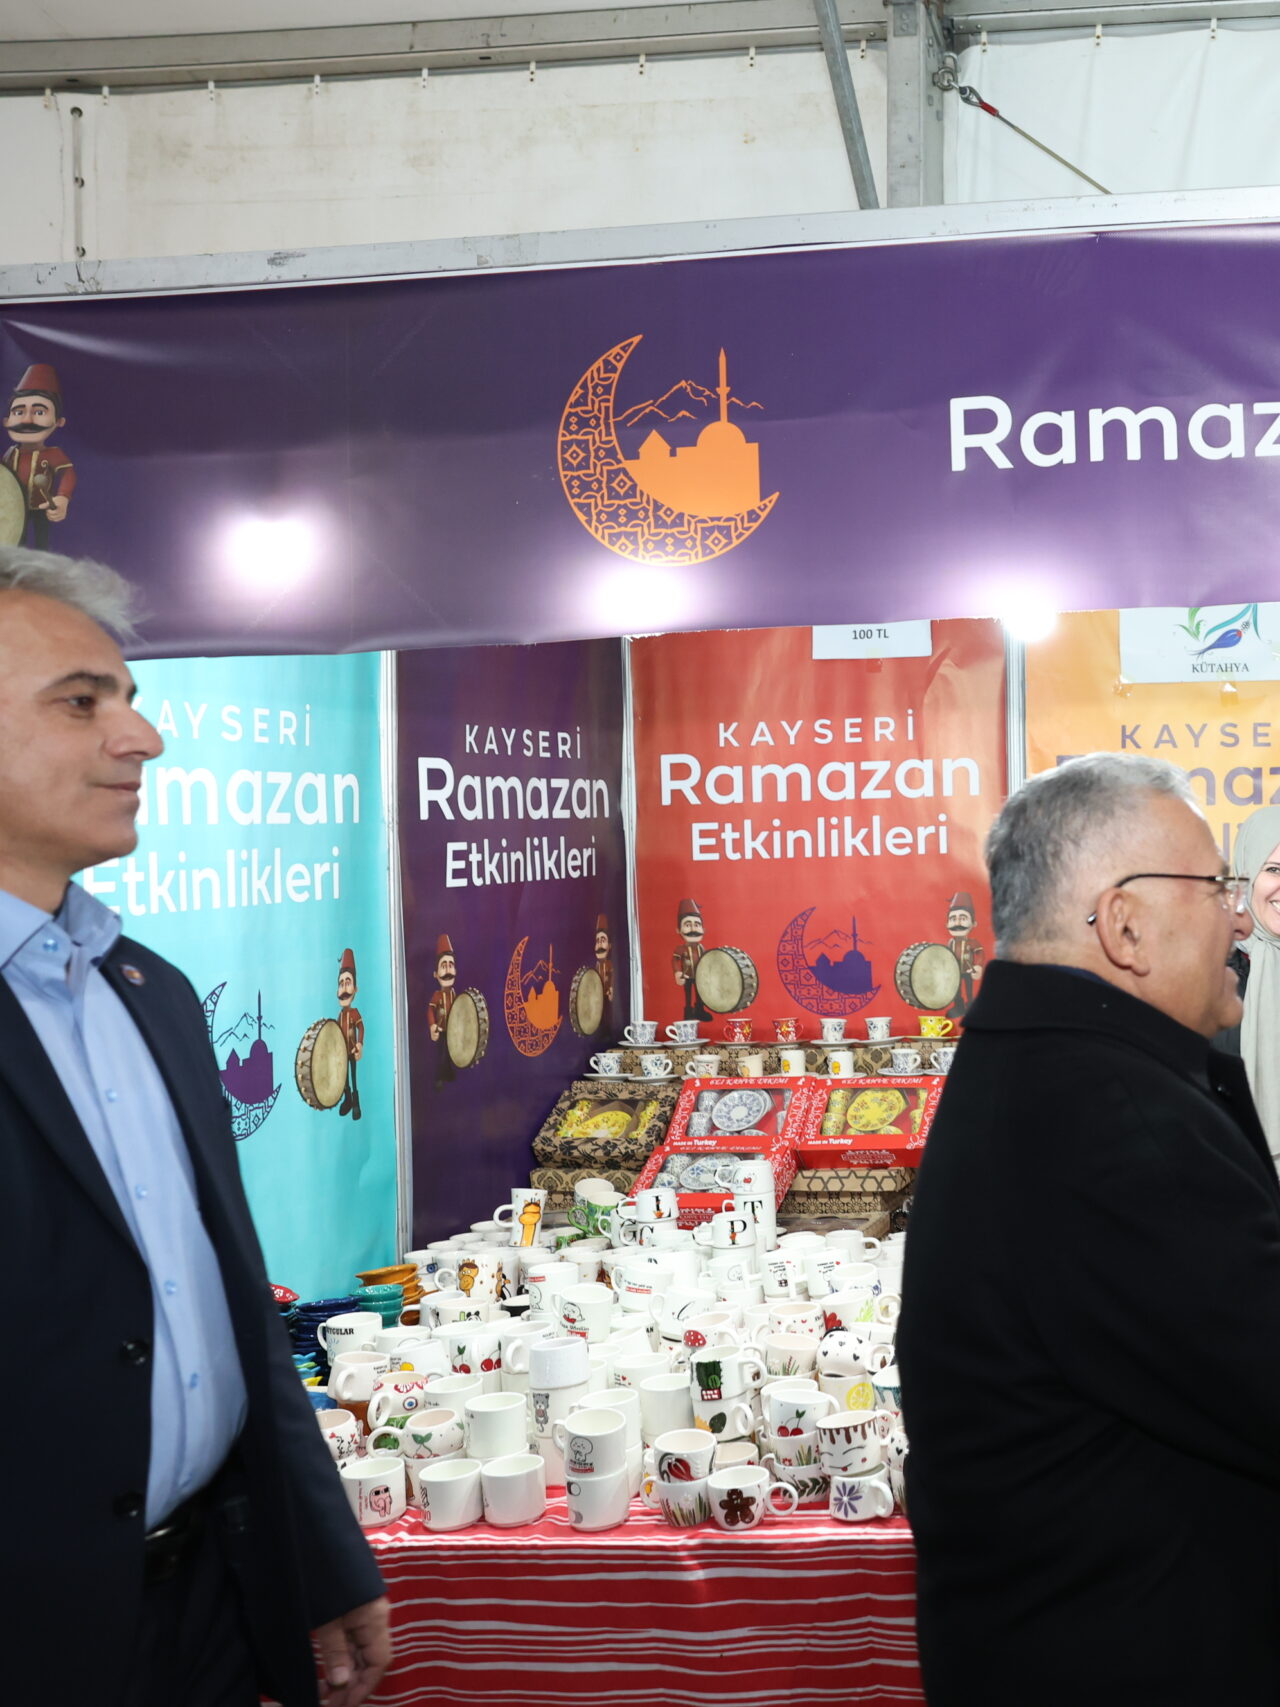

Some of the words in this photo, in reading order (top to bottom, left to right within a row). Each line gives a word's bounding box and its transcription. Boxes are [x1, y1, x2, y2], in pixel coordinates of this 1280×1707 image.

[852, 629, 873, 640] 100
[876, 628, 889, 639] TL
[1191, 662, 1250, 673] KÜTAHYA
[131, 696, 311, 747] AYSERİ
[465, 724, 581, 759] KAYSERİ
[718, 708, 914, 748] KAYSERİ
[135, 766, 360, 826] mazan
[417, 756, 610, 821] Ramazan
[659, 753, 980, 806] Ramazan
[691, 813, 948, 861] Etkinlikleri
[83, 846, 340, 917] Etkinlikleri
[446, 835, 596, 888] Etkinlikleri
[693, 1139, 717, 1147] Turkey
[828, 1138, 853, 1146] Turkey
